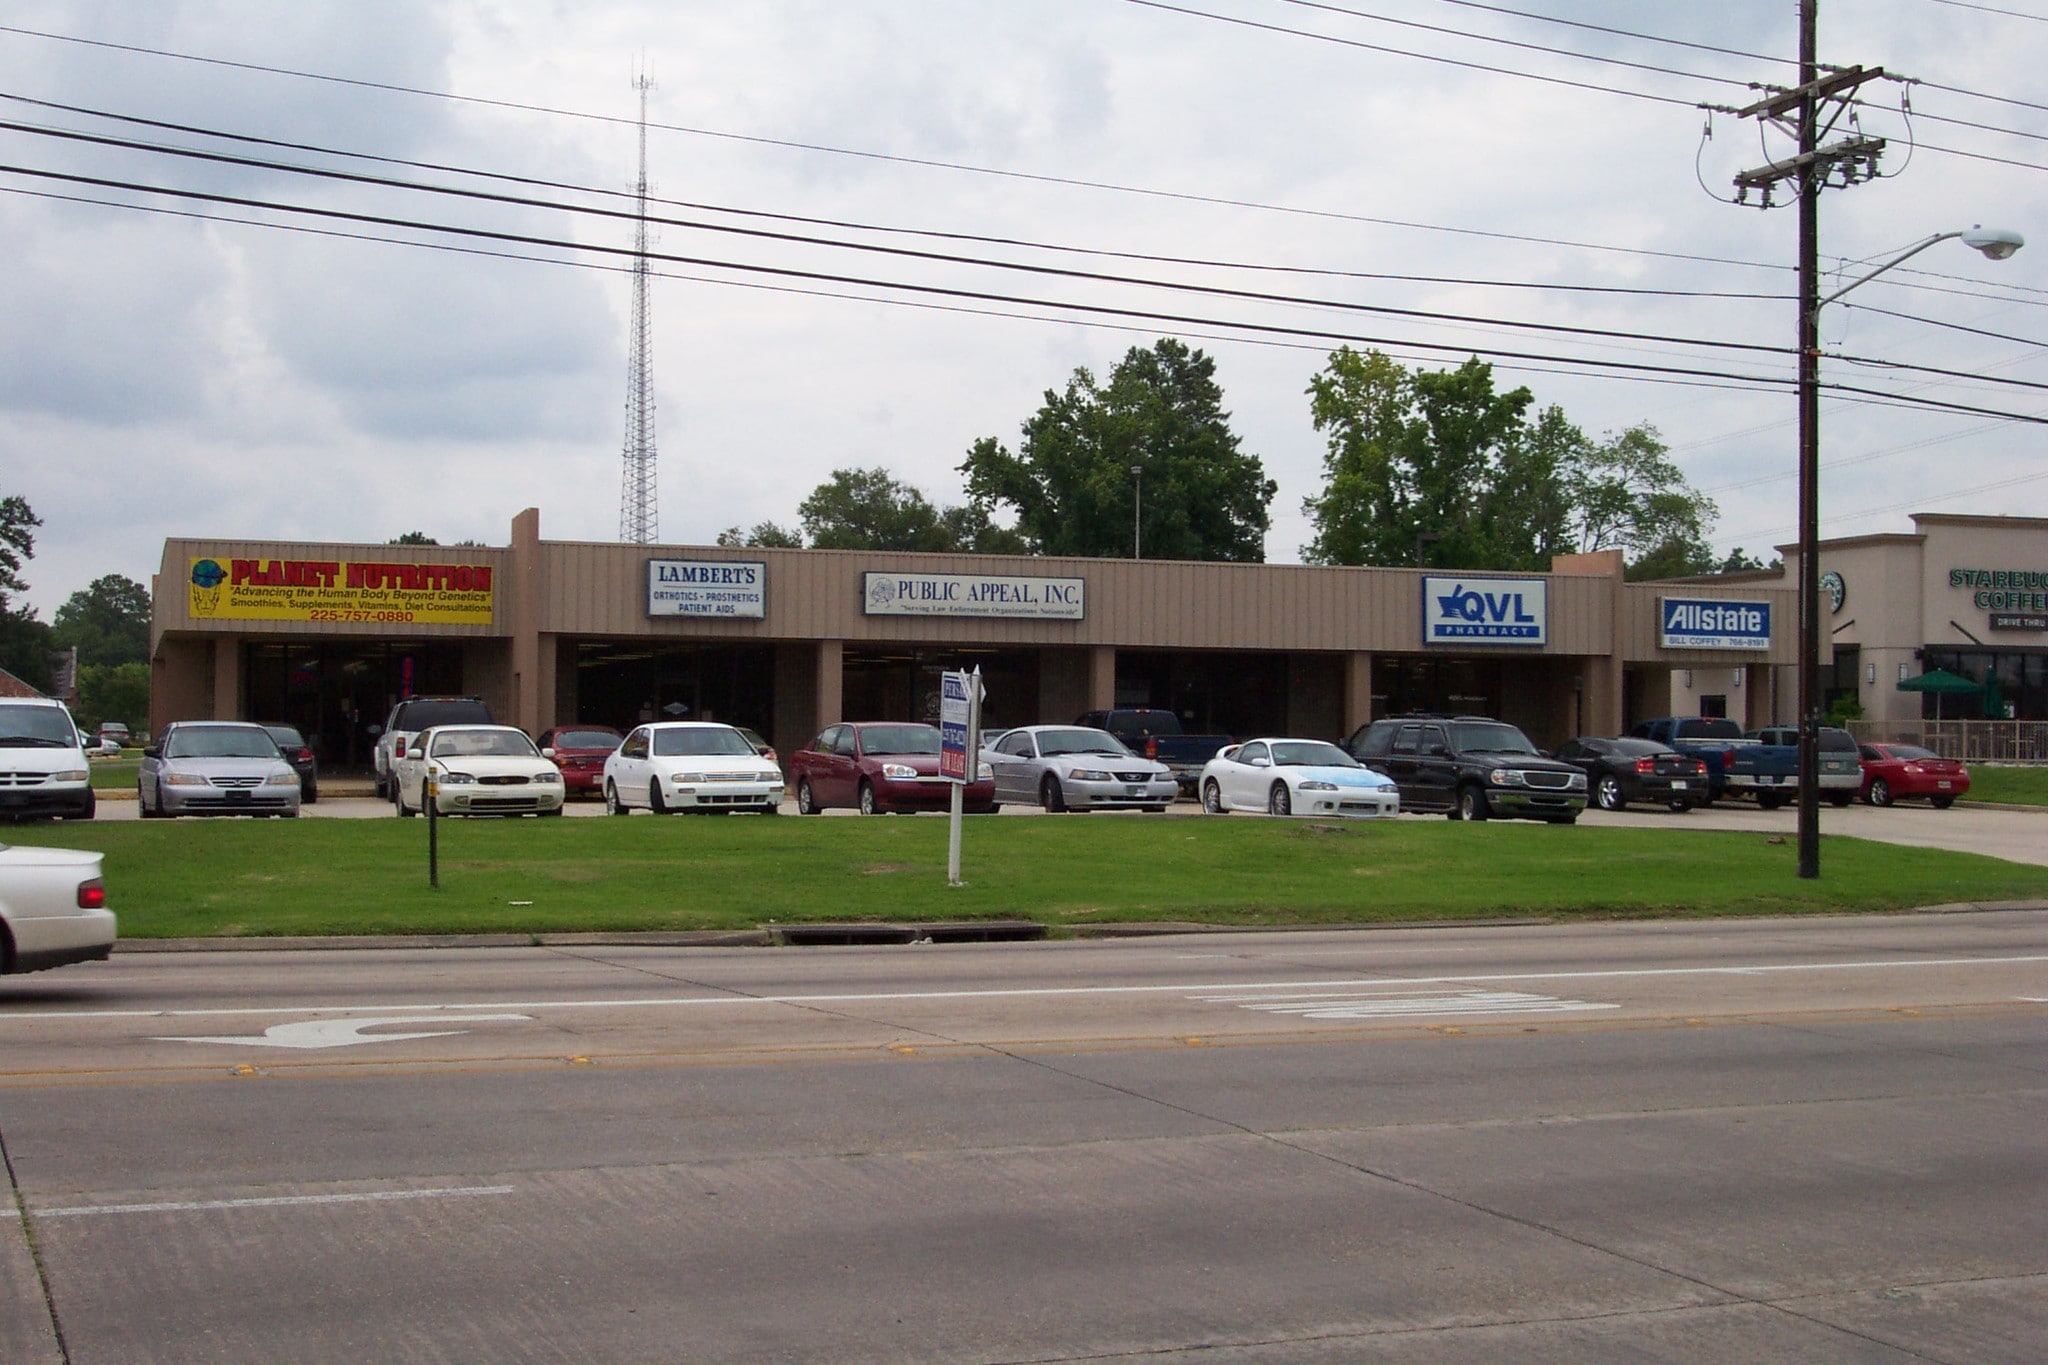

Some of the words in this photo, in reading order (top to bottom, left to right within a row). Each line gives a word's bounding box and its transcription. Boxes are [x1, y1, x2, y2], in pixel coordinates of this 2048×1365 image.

[231, 560, 340, 587] PLANET
[346, 563, 492, 591] NUTRITION
[659, 566, 755, 584] LAMBERT'S
[297, 588, 315, 597] the
[318, 589, 357, 598] Human
[361, 590, 389, 600] Body
[393, 590, 434, 601] Beyond
[654, 591, 698, 601] ORTHOTICS
[706, 592, 760, 603] PROSTHETICS
[898, 581, 960, 600] PUBLIC
[967, 583, 1038, 605] APPEAL,
[1045, 585, 1079, 604] INC.
[231, 598, 286, 608] Smoothies,
[289, 599, 355, 610] Supplements,
[358, 601, 401, 611] Vitamins,
[405, 602, 424, 610] Diet
[427, 602, 492, 612] Consultations
[678, 603, 712, 612] PATIENT
[716, 604, 735, 613] AIDS
[1460, 591, 1534, 623] QVL
[311, 611, 413, 622] 225-757-0880
[1667, 605, 1761, 632] Allstate
[1998, 618, 2020, 626] DRIVE
[2024, 618, 2046, 627] THRU
[1446, 626, 1528, 635] PHARMACY
[1690, 637, 1721, 646] COFFEY
